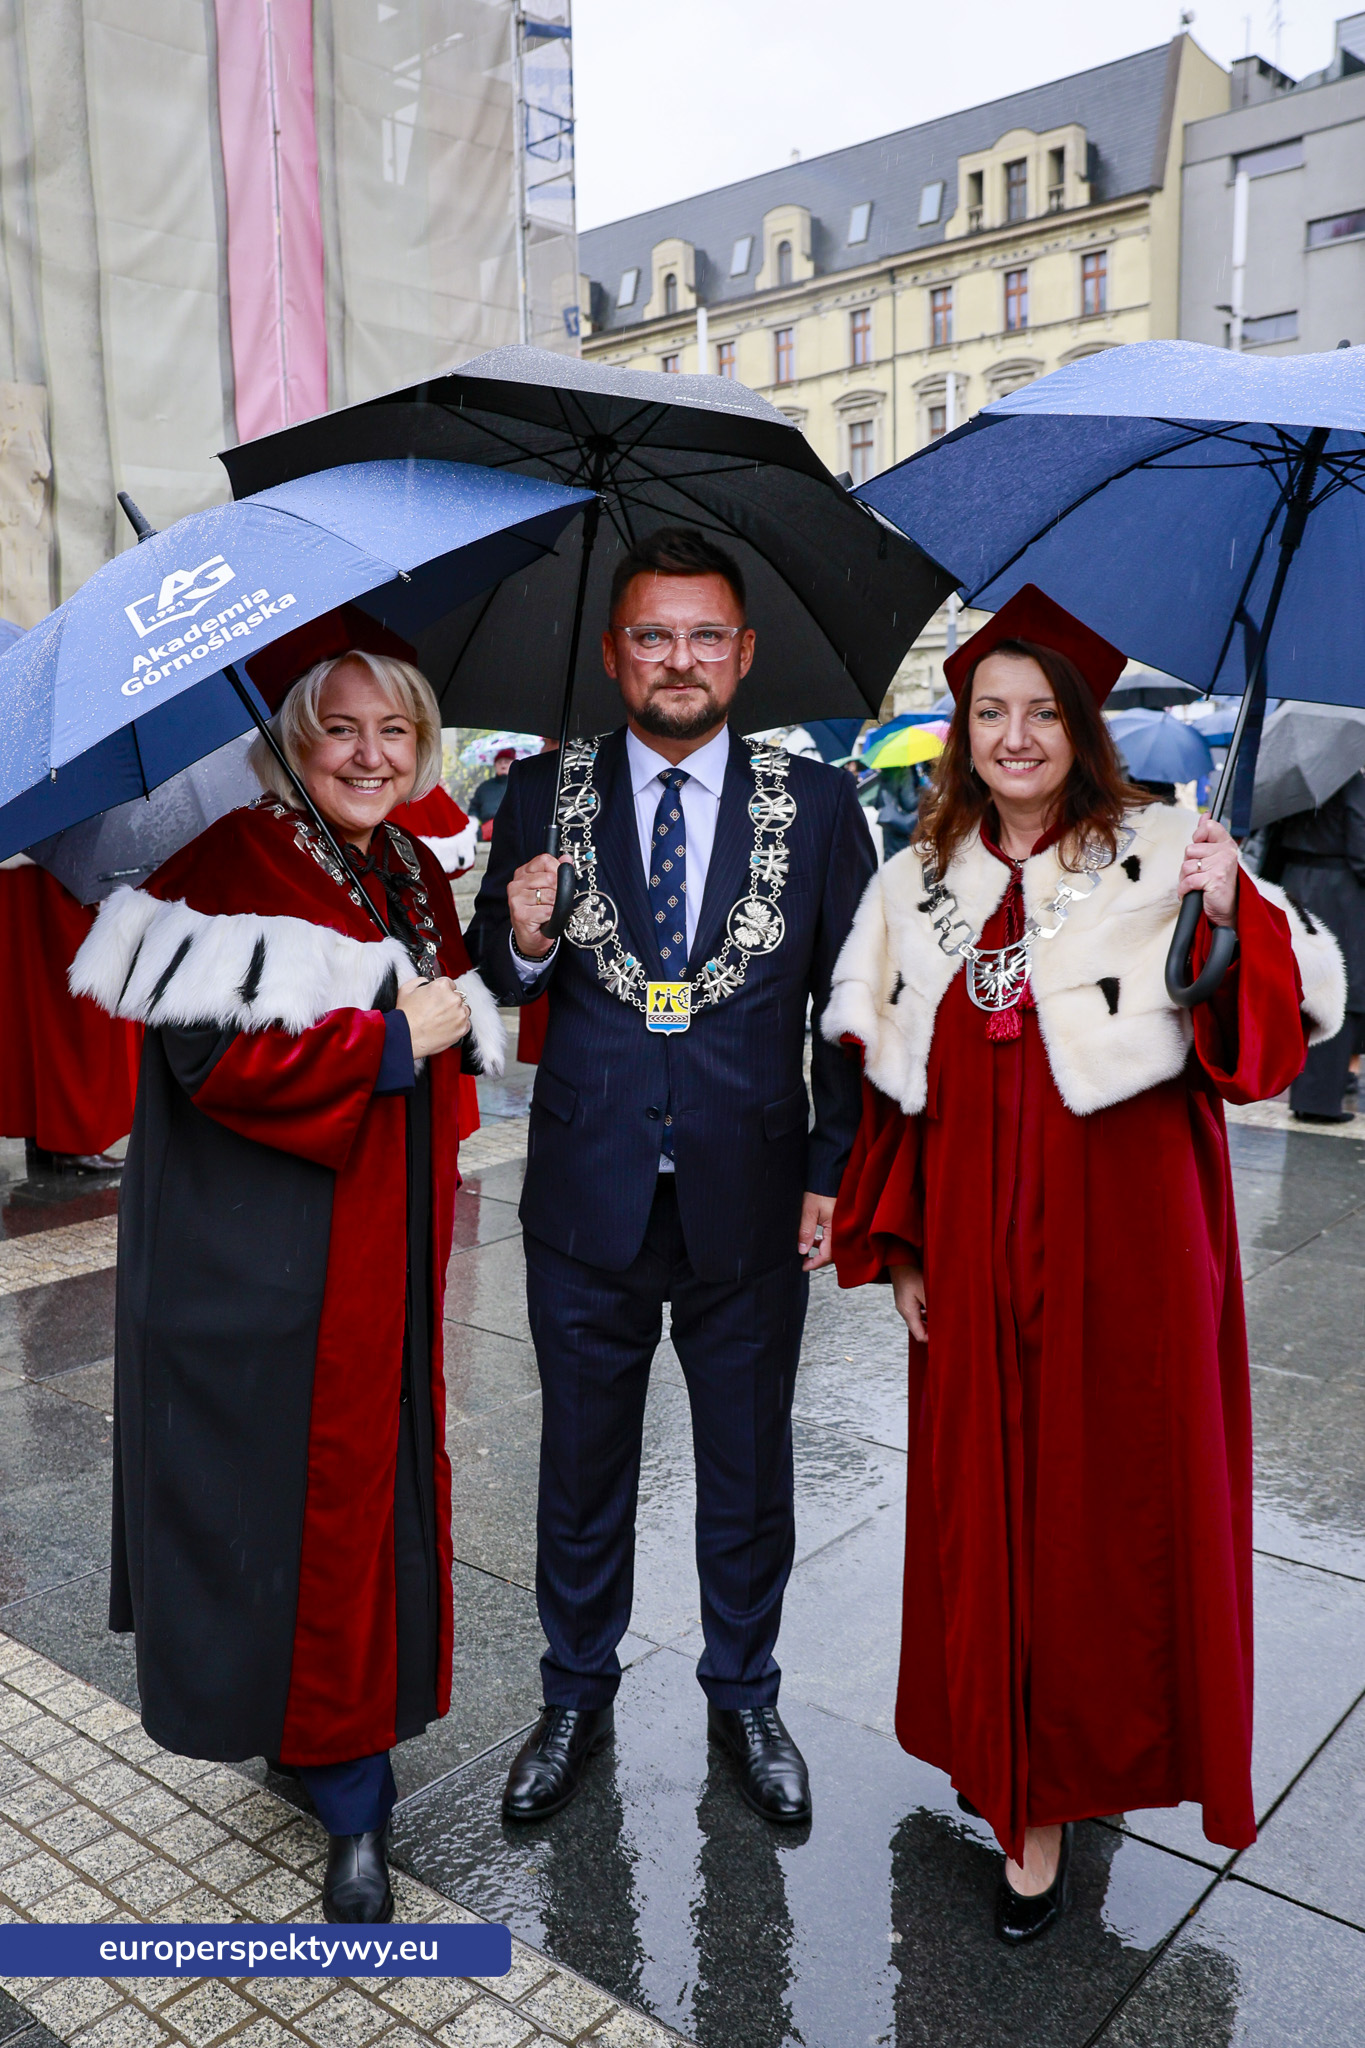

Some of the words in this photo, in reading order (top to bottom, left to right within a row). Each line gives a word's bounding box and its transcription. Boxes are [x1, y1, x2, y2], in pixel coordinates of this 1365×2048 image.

[120, 593, 297, 696] Górnośląska
[132, 588, 270, 673] Akademia
[147, 601, 185, 623] 1991
